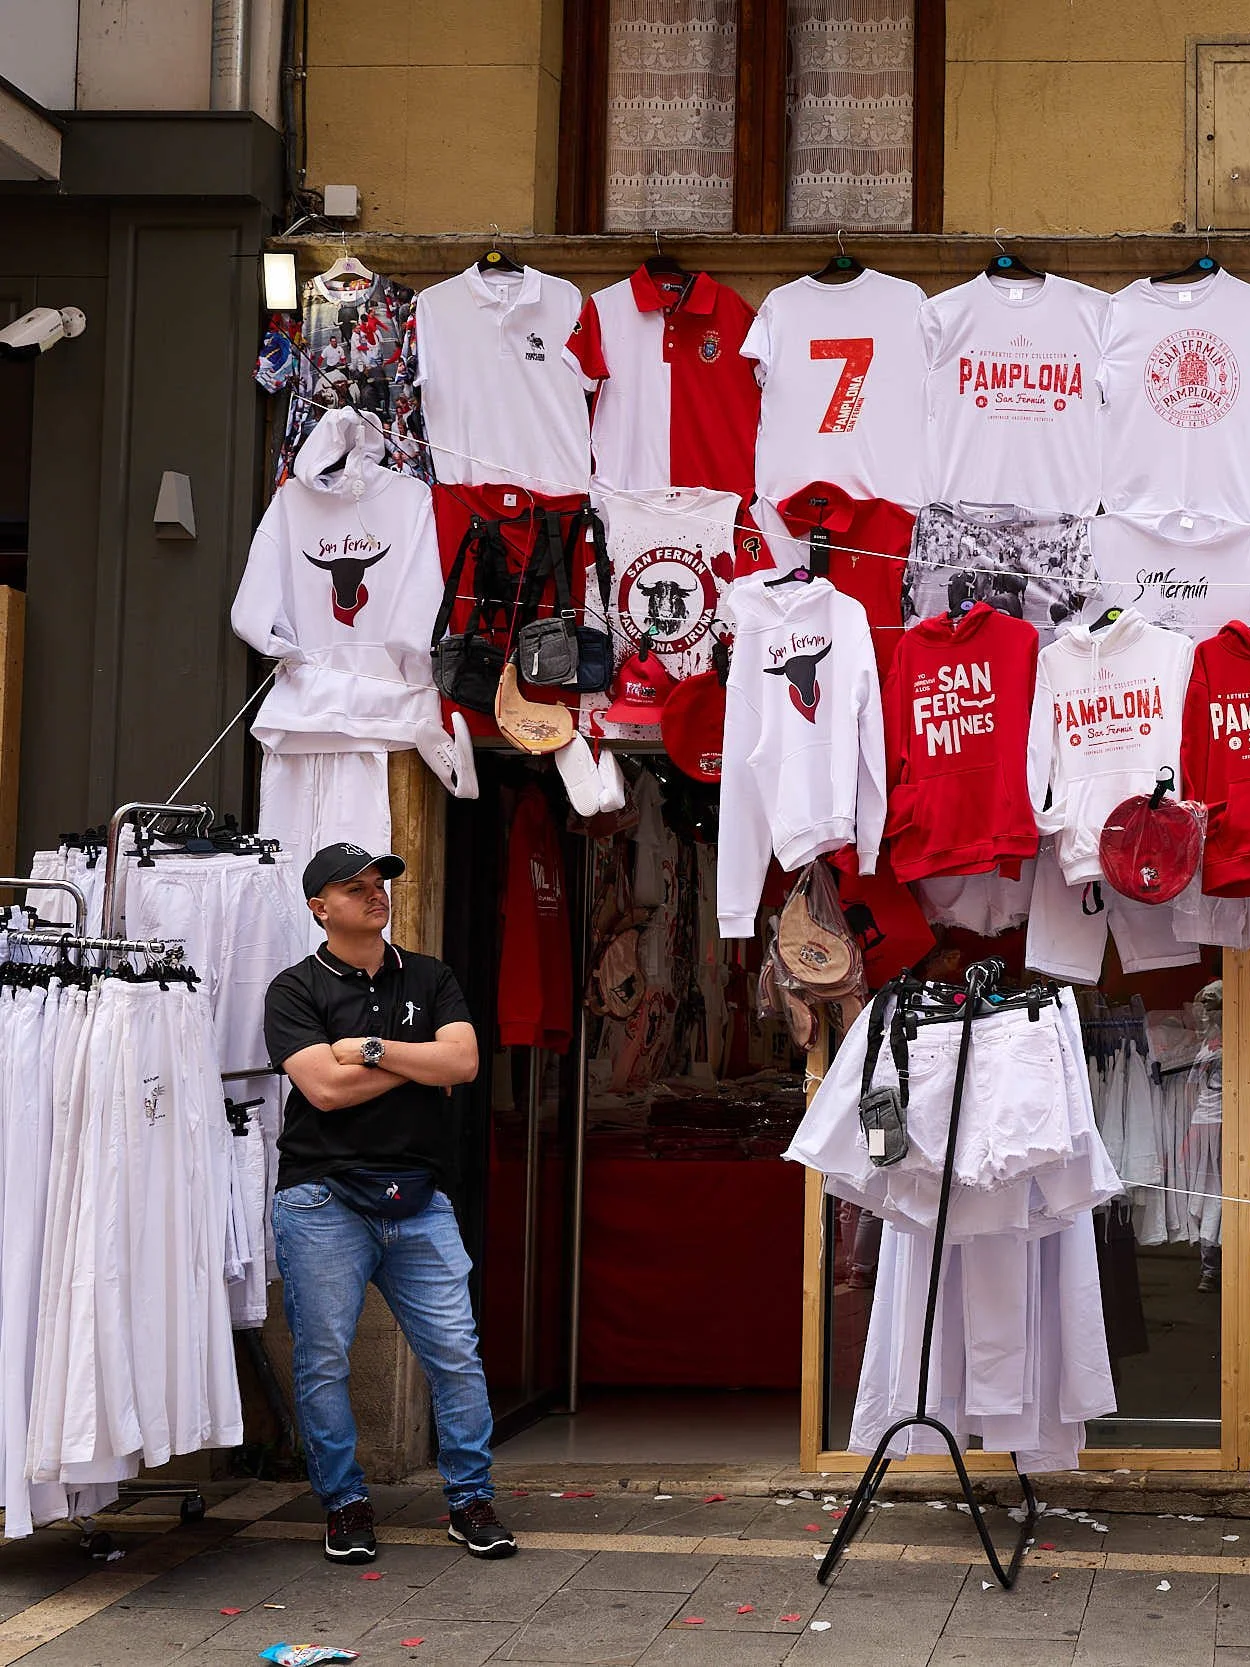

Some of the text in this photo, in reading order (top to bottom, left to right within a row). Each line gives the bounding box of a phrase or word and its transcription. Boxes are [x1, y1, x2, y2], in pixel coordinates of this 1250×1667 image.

[1158, 339, 1226, 368] SAN FERMIN
[809, 337, 874, 433] 7
[959, 356, 1083, 400] PAMPLONA
[995, 392, 1013, 404] San
[1162, 386, 1222, 408] PAMPLONA
[831, 375, 865, 432] PAMPLONA
[626, 549, 707, 578] SAN FERMIN
[937, 661, 992, 695] SAN
[913, 691, 961, 736] FER
[1053, 685, 1164, 733] PAMPLONA
[926, 712, 995, 757] MINES
